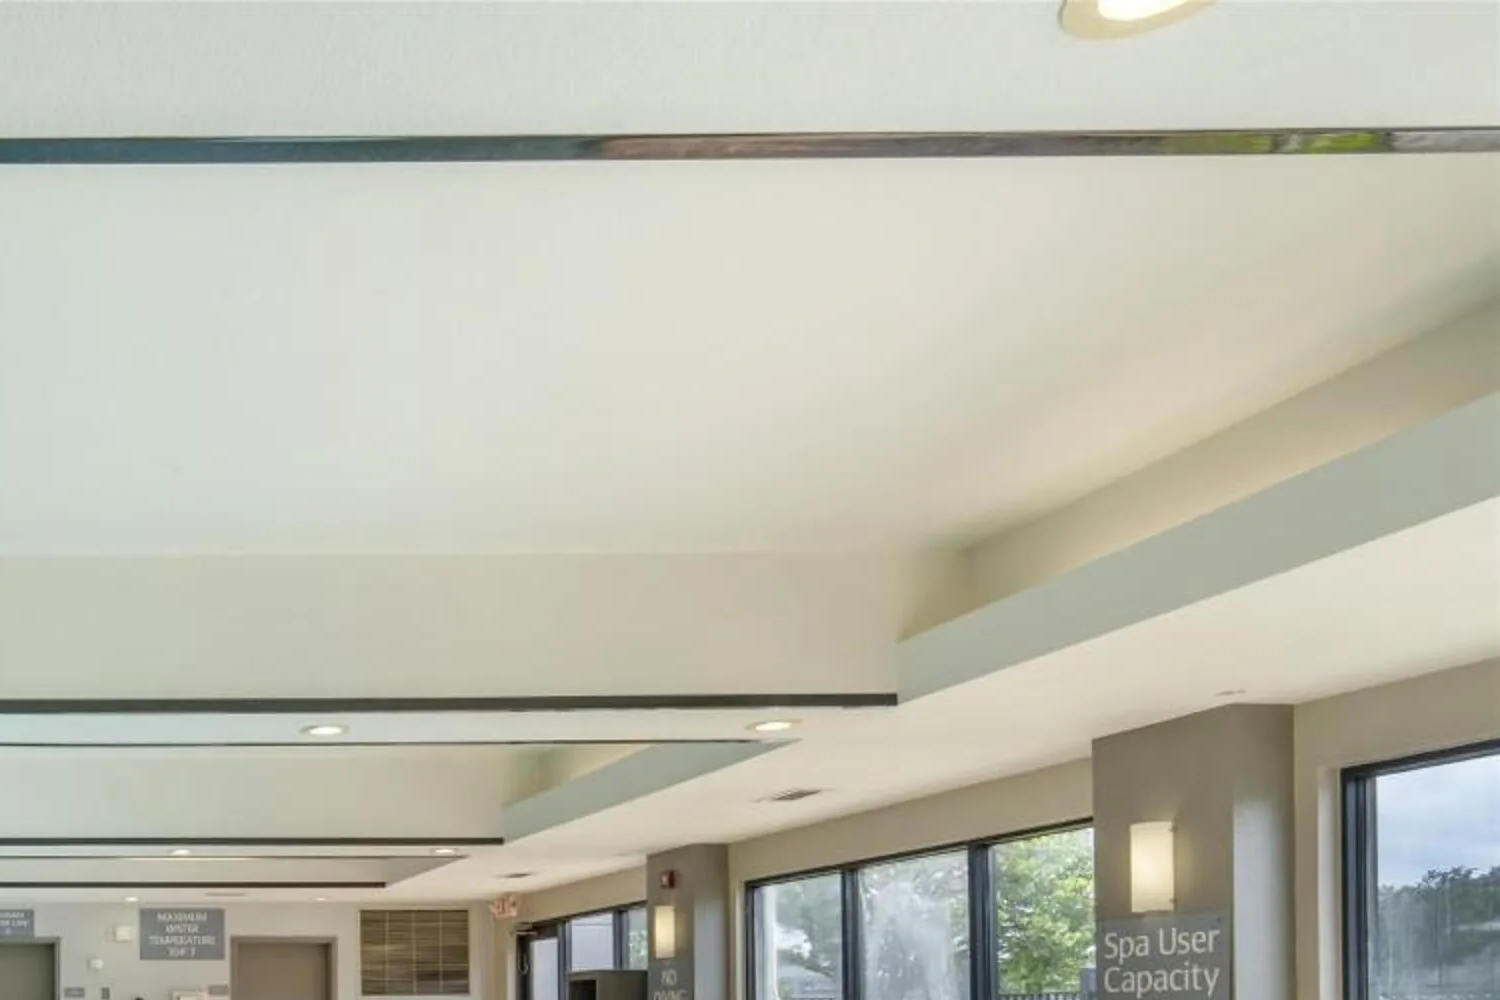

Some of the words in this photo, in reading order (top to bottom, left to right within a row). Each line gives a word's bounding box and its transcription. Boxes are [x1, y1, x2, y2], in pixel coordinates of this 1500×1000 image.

[1104, 932, 1150, 965] Spa
[1158, 927, 1220, 956] User
[660, 969, 677, 986] NO
[1103, 960, 1221, 999] Capacity
